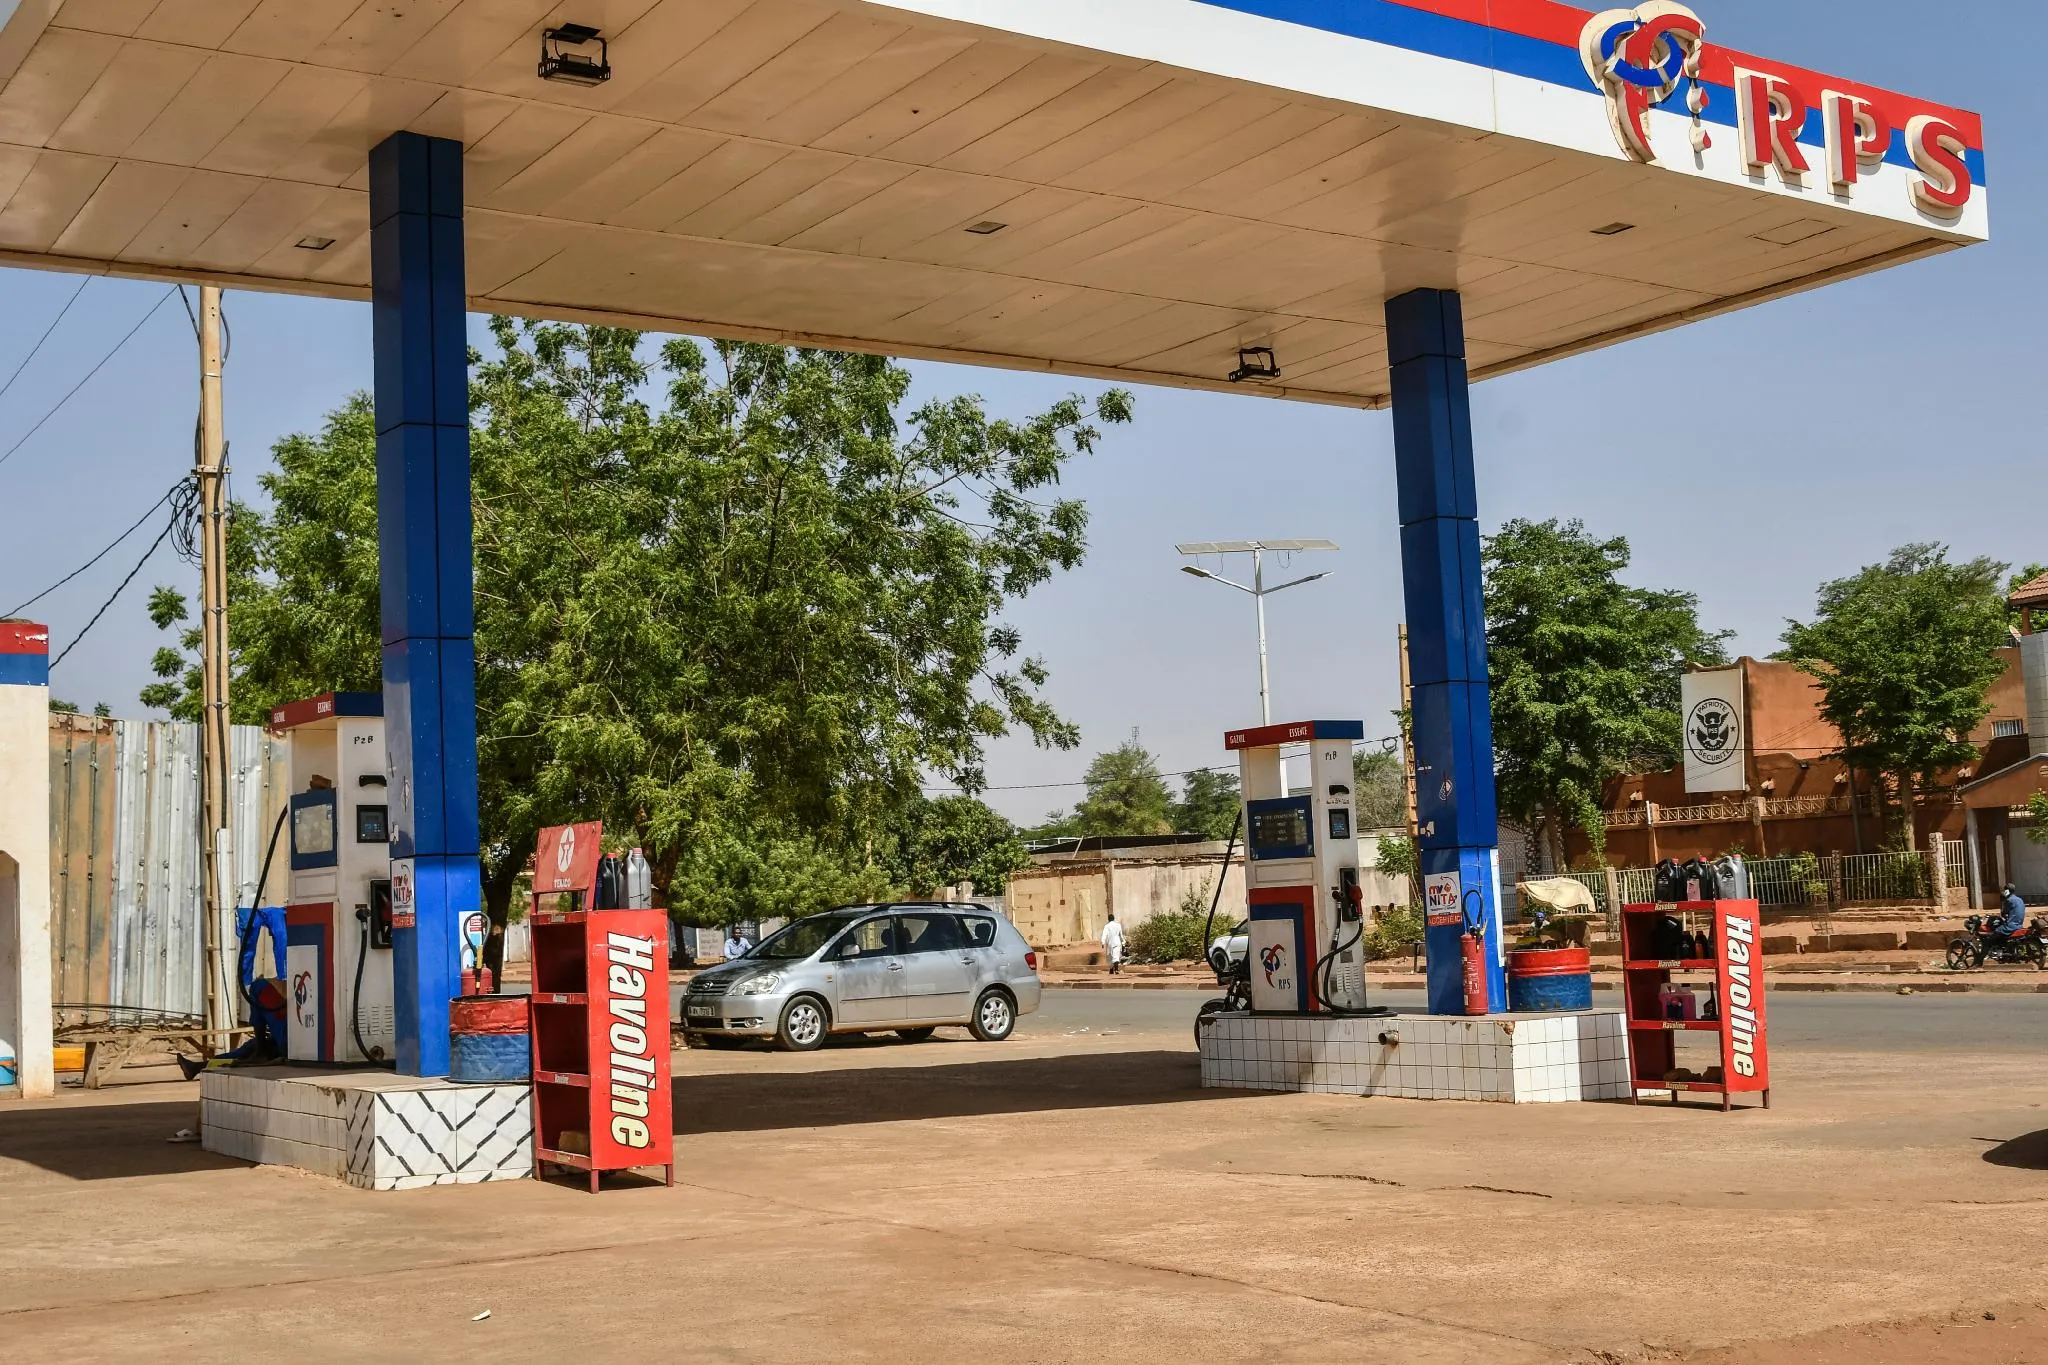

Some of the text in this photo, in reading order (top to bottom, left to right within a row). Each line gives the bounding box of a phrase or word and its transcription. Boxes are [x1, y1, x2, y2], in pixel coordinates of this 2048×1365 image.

[1736, 69, 1971, 214] RPS
[1698, 701, 1727, 713] PATRIOTE
[1429, 893, 1456, 907] NITA
[1278, 978, 1291, 990] RPS
[1725, 913, 1757, 1078] Havoline
[607, 931, 656, 1149] Havoline
